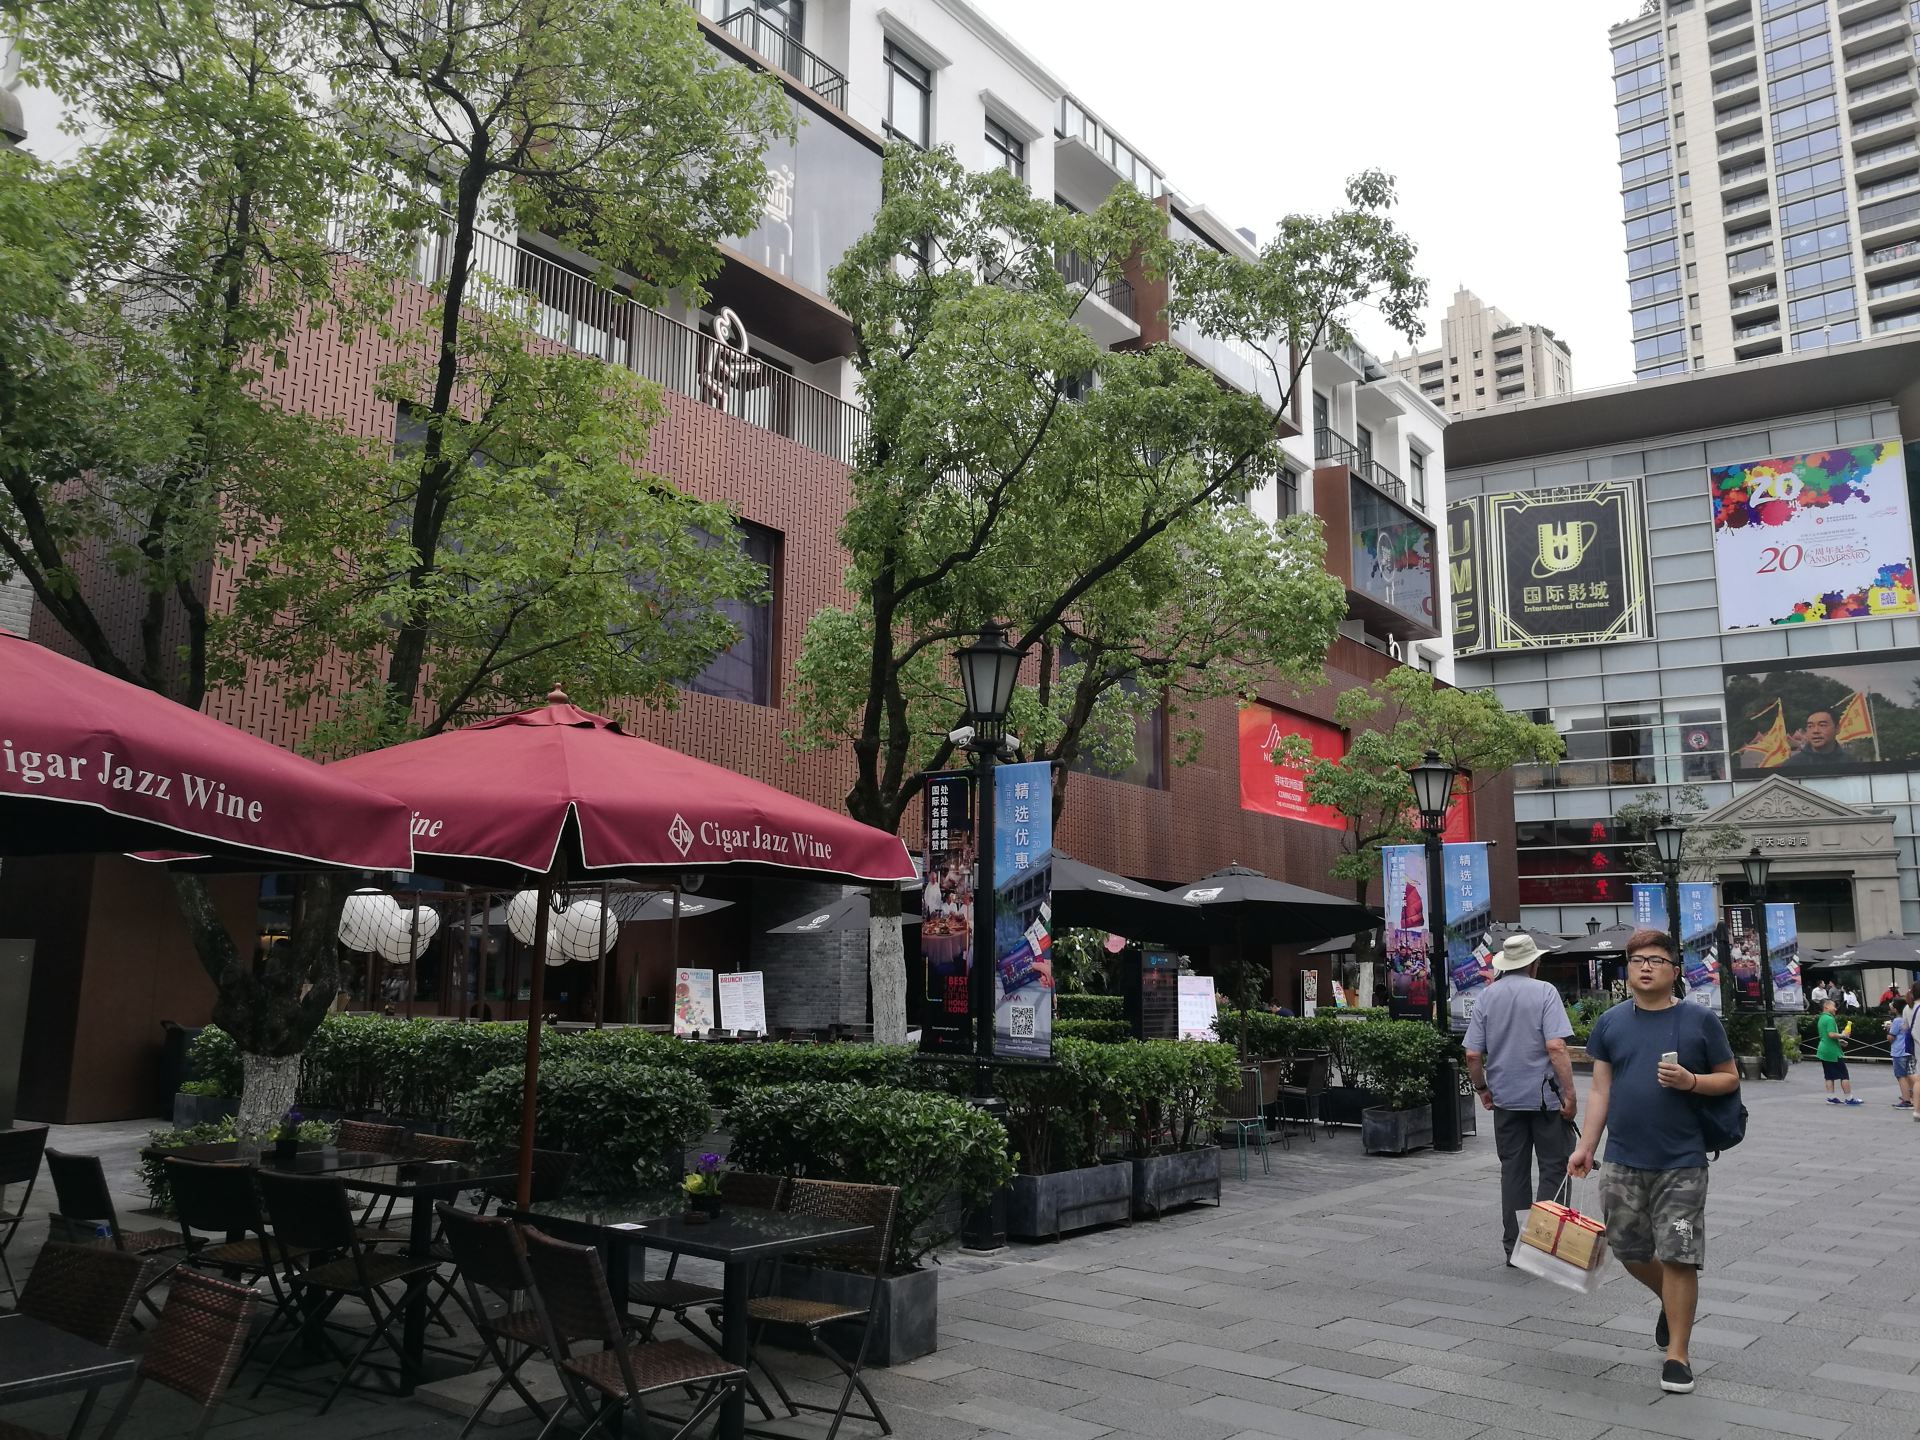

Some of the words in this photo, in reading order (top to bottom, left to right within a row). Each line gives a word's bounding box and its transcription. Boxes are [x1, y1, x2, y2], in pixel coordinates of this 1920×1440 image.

[1757, 544, 1803, 574] 20
[1809, 551, 1866, 565] ANNIVERSARY
[1448, 519, 1476, 634] UME
[1523, 581, 1610, 604] 国际影城
[1524, 602, 1574, 613] International
[1575, 600, 1610, 609] Cineplex
[97, 751, 173, 801] Jazz
[182, 772, 264, 823] Wine
[1014, 782, 1030, 869] 精选优惠
[700, 821, 750, 853] Cigar
[752, 825, 789, 853] Jazz
[792, 831, 832, 860] Wine
[1459, 854, 1474, 912] 精选优惠
[1691, 890, 1704, 932] 精选优惠
[720, 976, 743, 984] BRUNCH
[948, 976, 968, 985] BEST
[948, 999, 968, 1007] HONG
[948, 1006, 968, 1014] KONG
